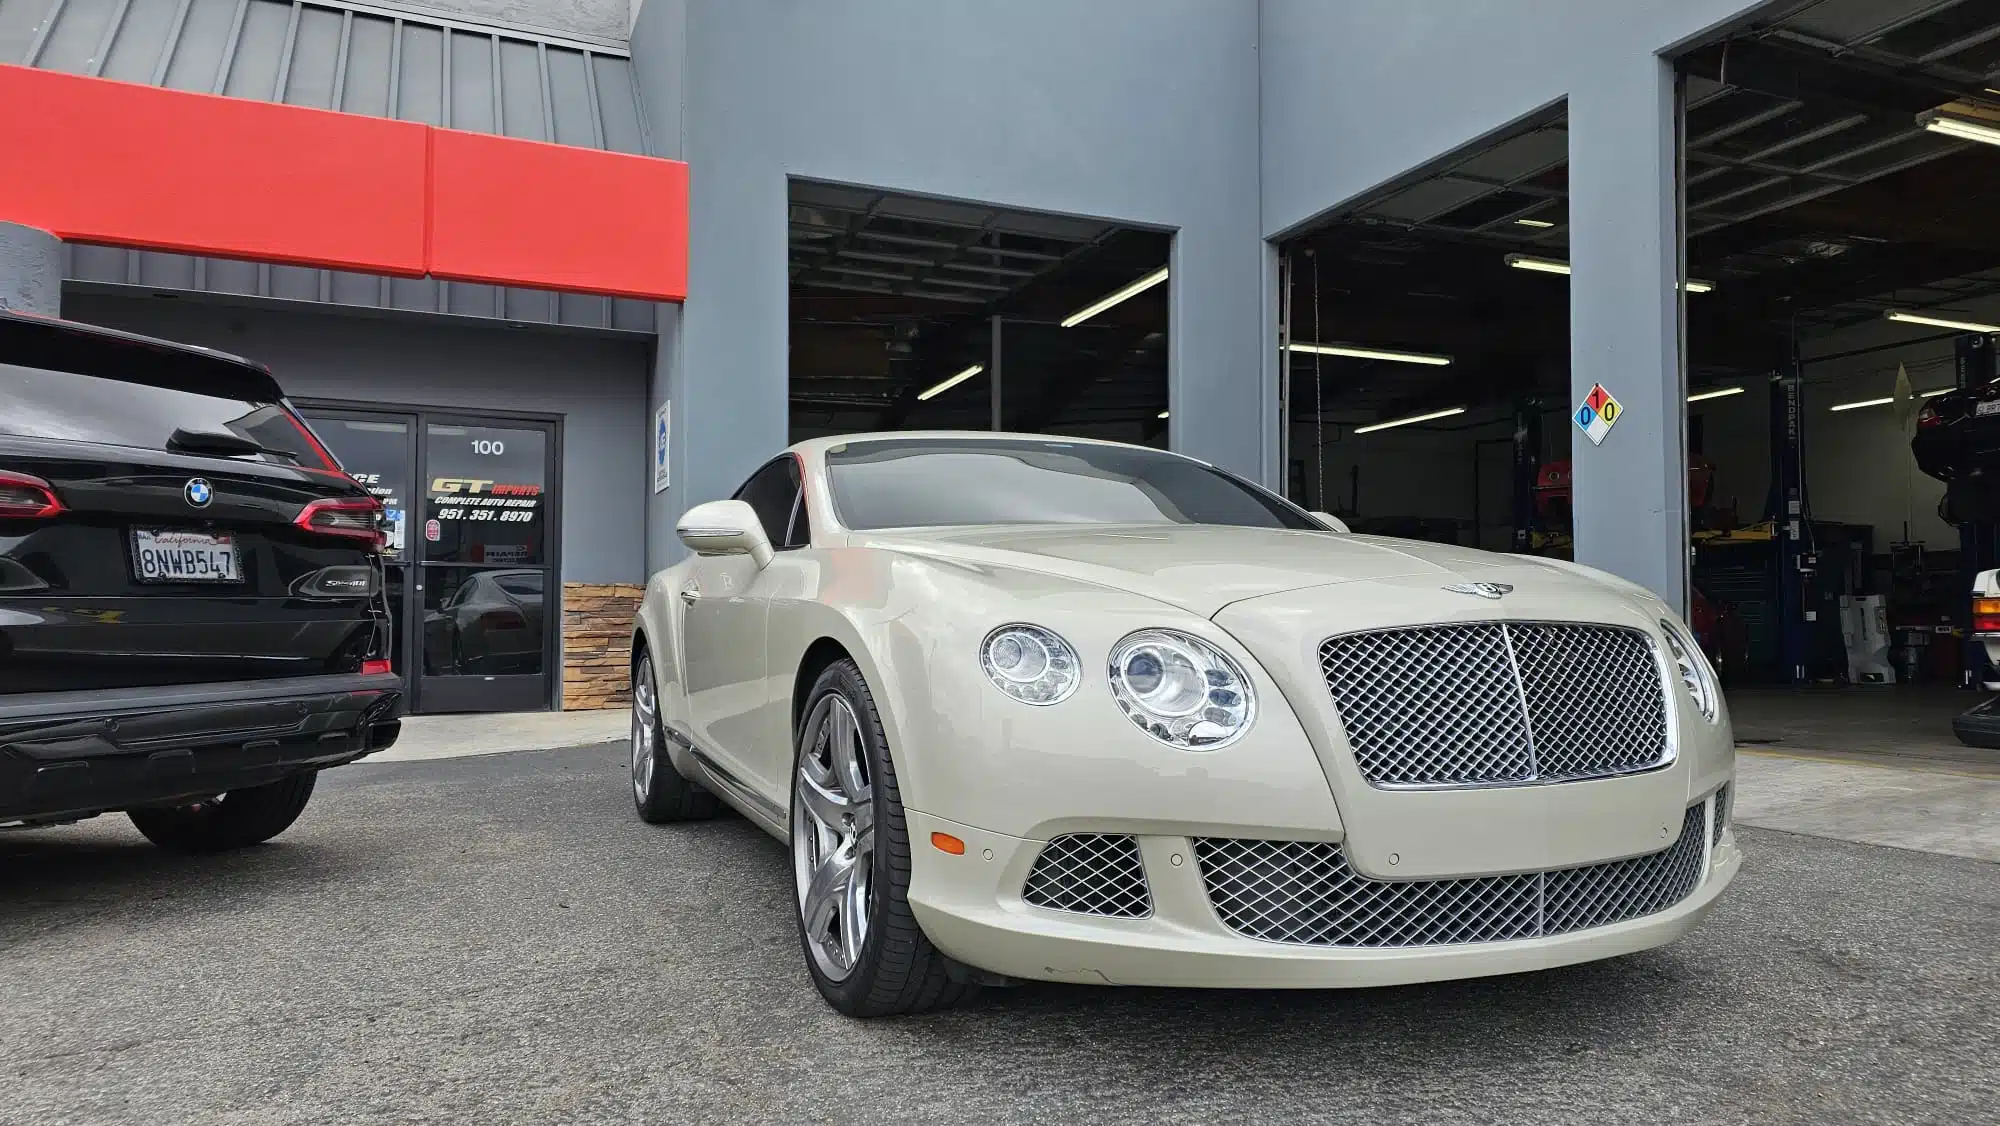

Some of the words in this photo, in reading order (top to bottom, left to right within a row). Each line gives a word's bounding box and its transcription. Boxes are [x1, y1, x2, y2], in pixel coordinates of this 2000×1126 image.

[1592, 390, 1600, 409] 1
[1580, 406, 1592, 426] 0
[1604, 402, 1615, 422] 0
[471, 440, 504, 455] 100
[431, 478, 494, 494] GT
[491, 483, 541, 496] IMPORTS
[434, 496, 482, 506] COMPLETE
[480, 498, 506, 507] AUTO
[504, 499, 537, 508] REPAIR
[154, 531, 217, 548] California
[142, 548, 232, 576] 8NWB547
